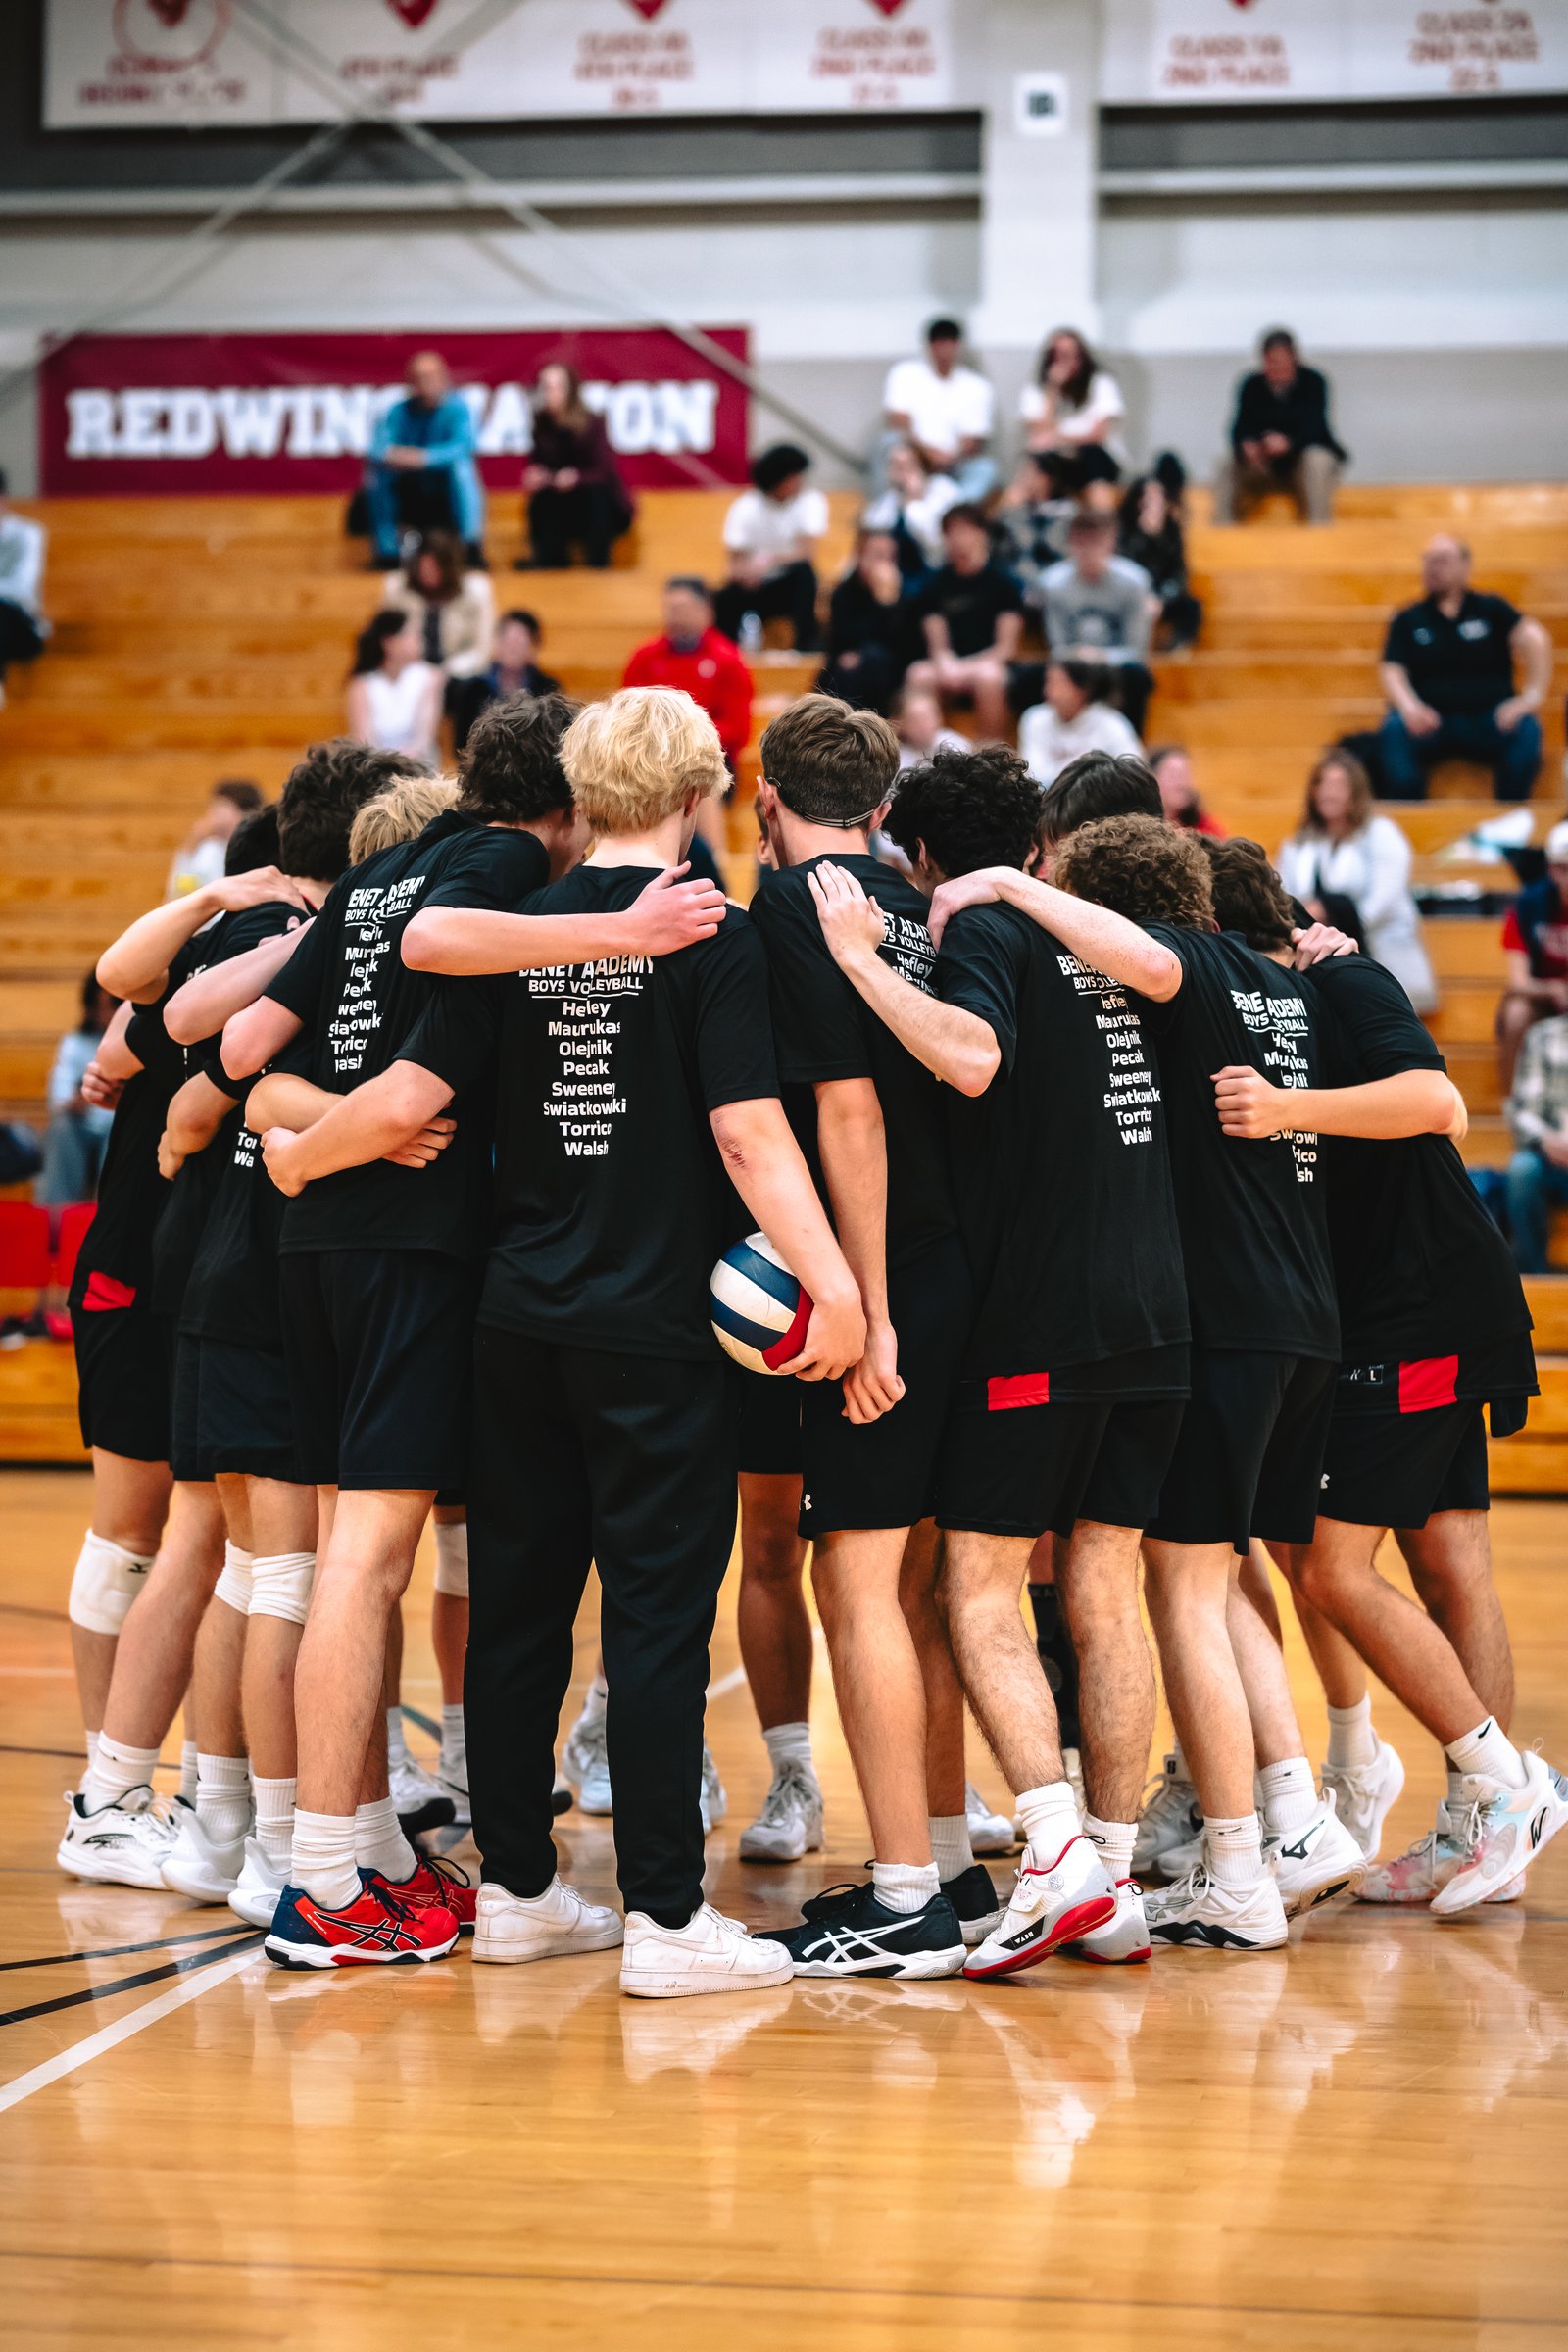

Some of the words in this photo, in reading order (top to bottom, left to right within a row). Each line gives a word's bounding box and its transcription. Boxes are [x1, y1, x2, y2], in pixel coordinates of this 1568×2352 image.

[347, 887, 384, 908] ENET
[345, 908, 368, 922] BOYS
[580, 954, 655, 979] AADEMY
[1056, 955, 1096, 976] BENE
[528, 979, 566, 993] BOYS
[569, 975, 644, 995] VOLEYBALL
[1072, 975, 1097, 990] BOYS
[563, 1000, 611, 1018] Heley
[1242, 1012, 1270, 1027] BOYS
[559, 1039, 612, 1059] Olejnik
[1111, 1049, 1145, 1067] Pecak
[564, 1058, 610, 1076] Pecak
[1108, 1071, 1152, 1088] Sweeney
[543, 1098, 627, 1116] Swiatkowki
[564, 1140, 609, 1156] Walsh
